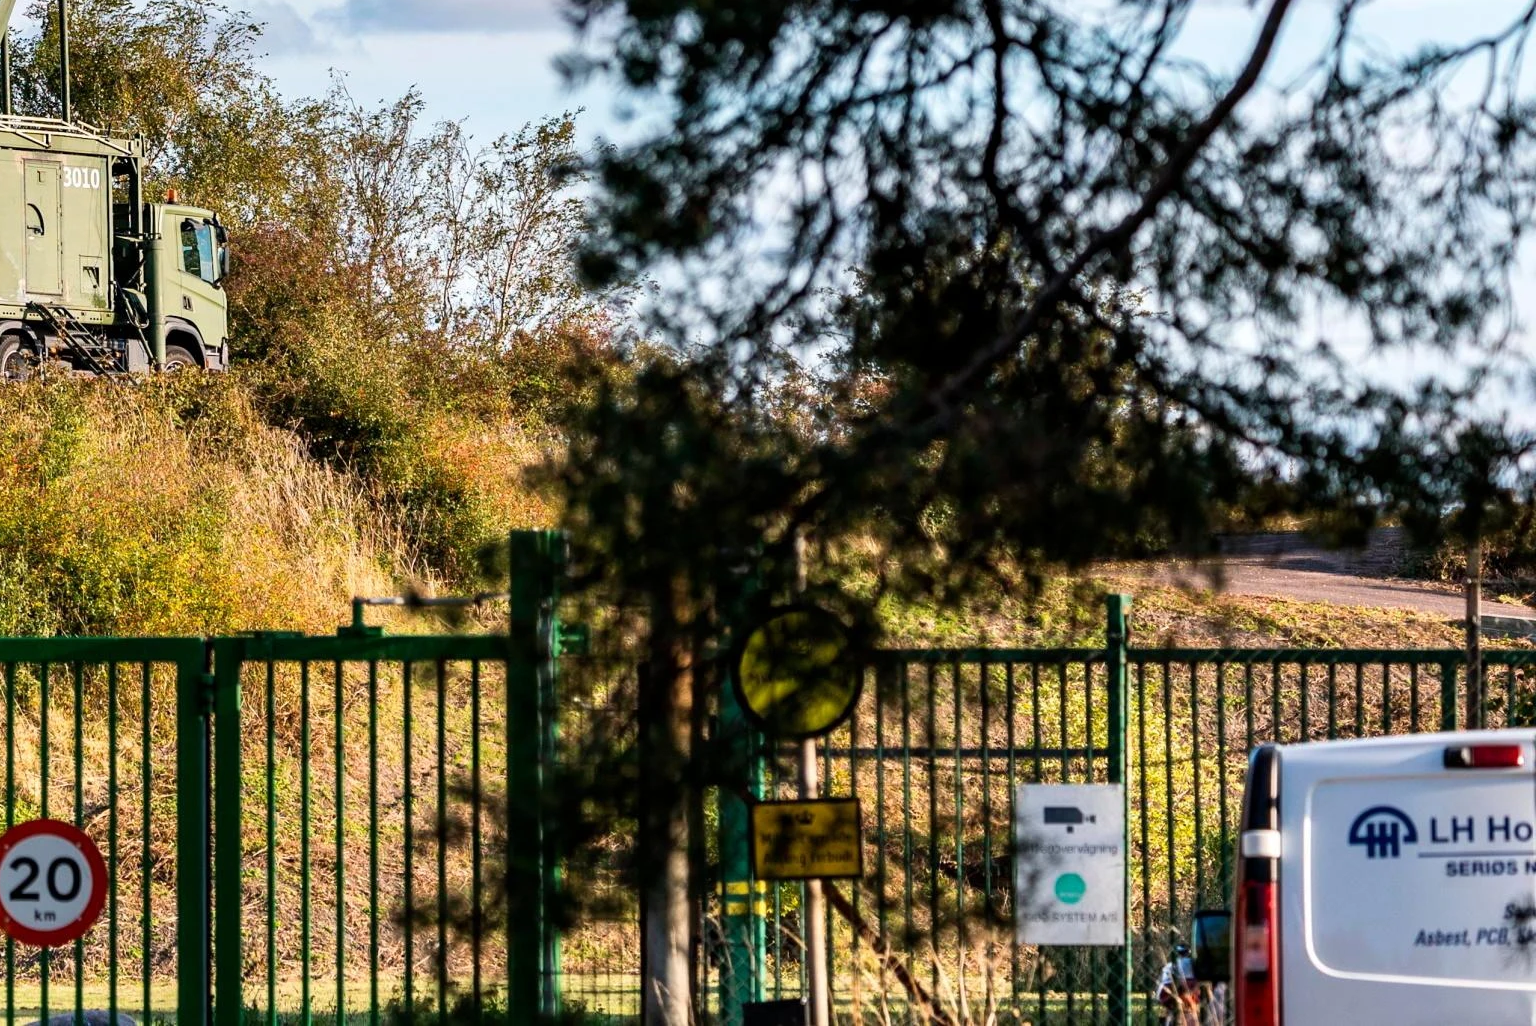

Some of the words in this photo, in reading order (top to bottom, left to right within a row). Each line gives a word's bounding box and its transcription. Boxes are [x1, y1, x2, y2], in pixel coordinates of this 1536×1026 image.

[63, 166, 100, 189] 3010
[1430, 816, 1474, 843] LH
[1446, 860, 1518, 876] SERIØS
[9, 856, 82, 902] 20
[34, 909, 56, 922] km
[1414, 928, 1471, 947] Asbest,
